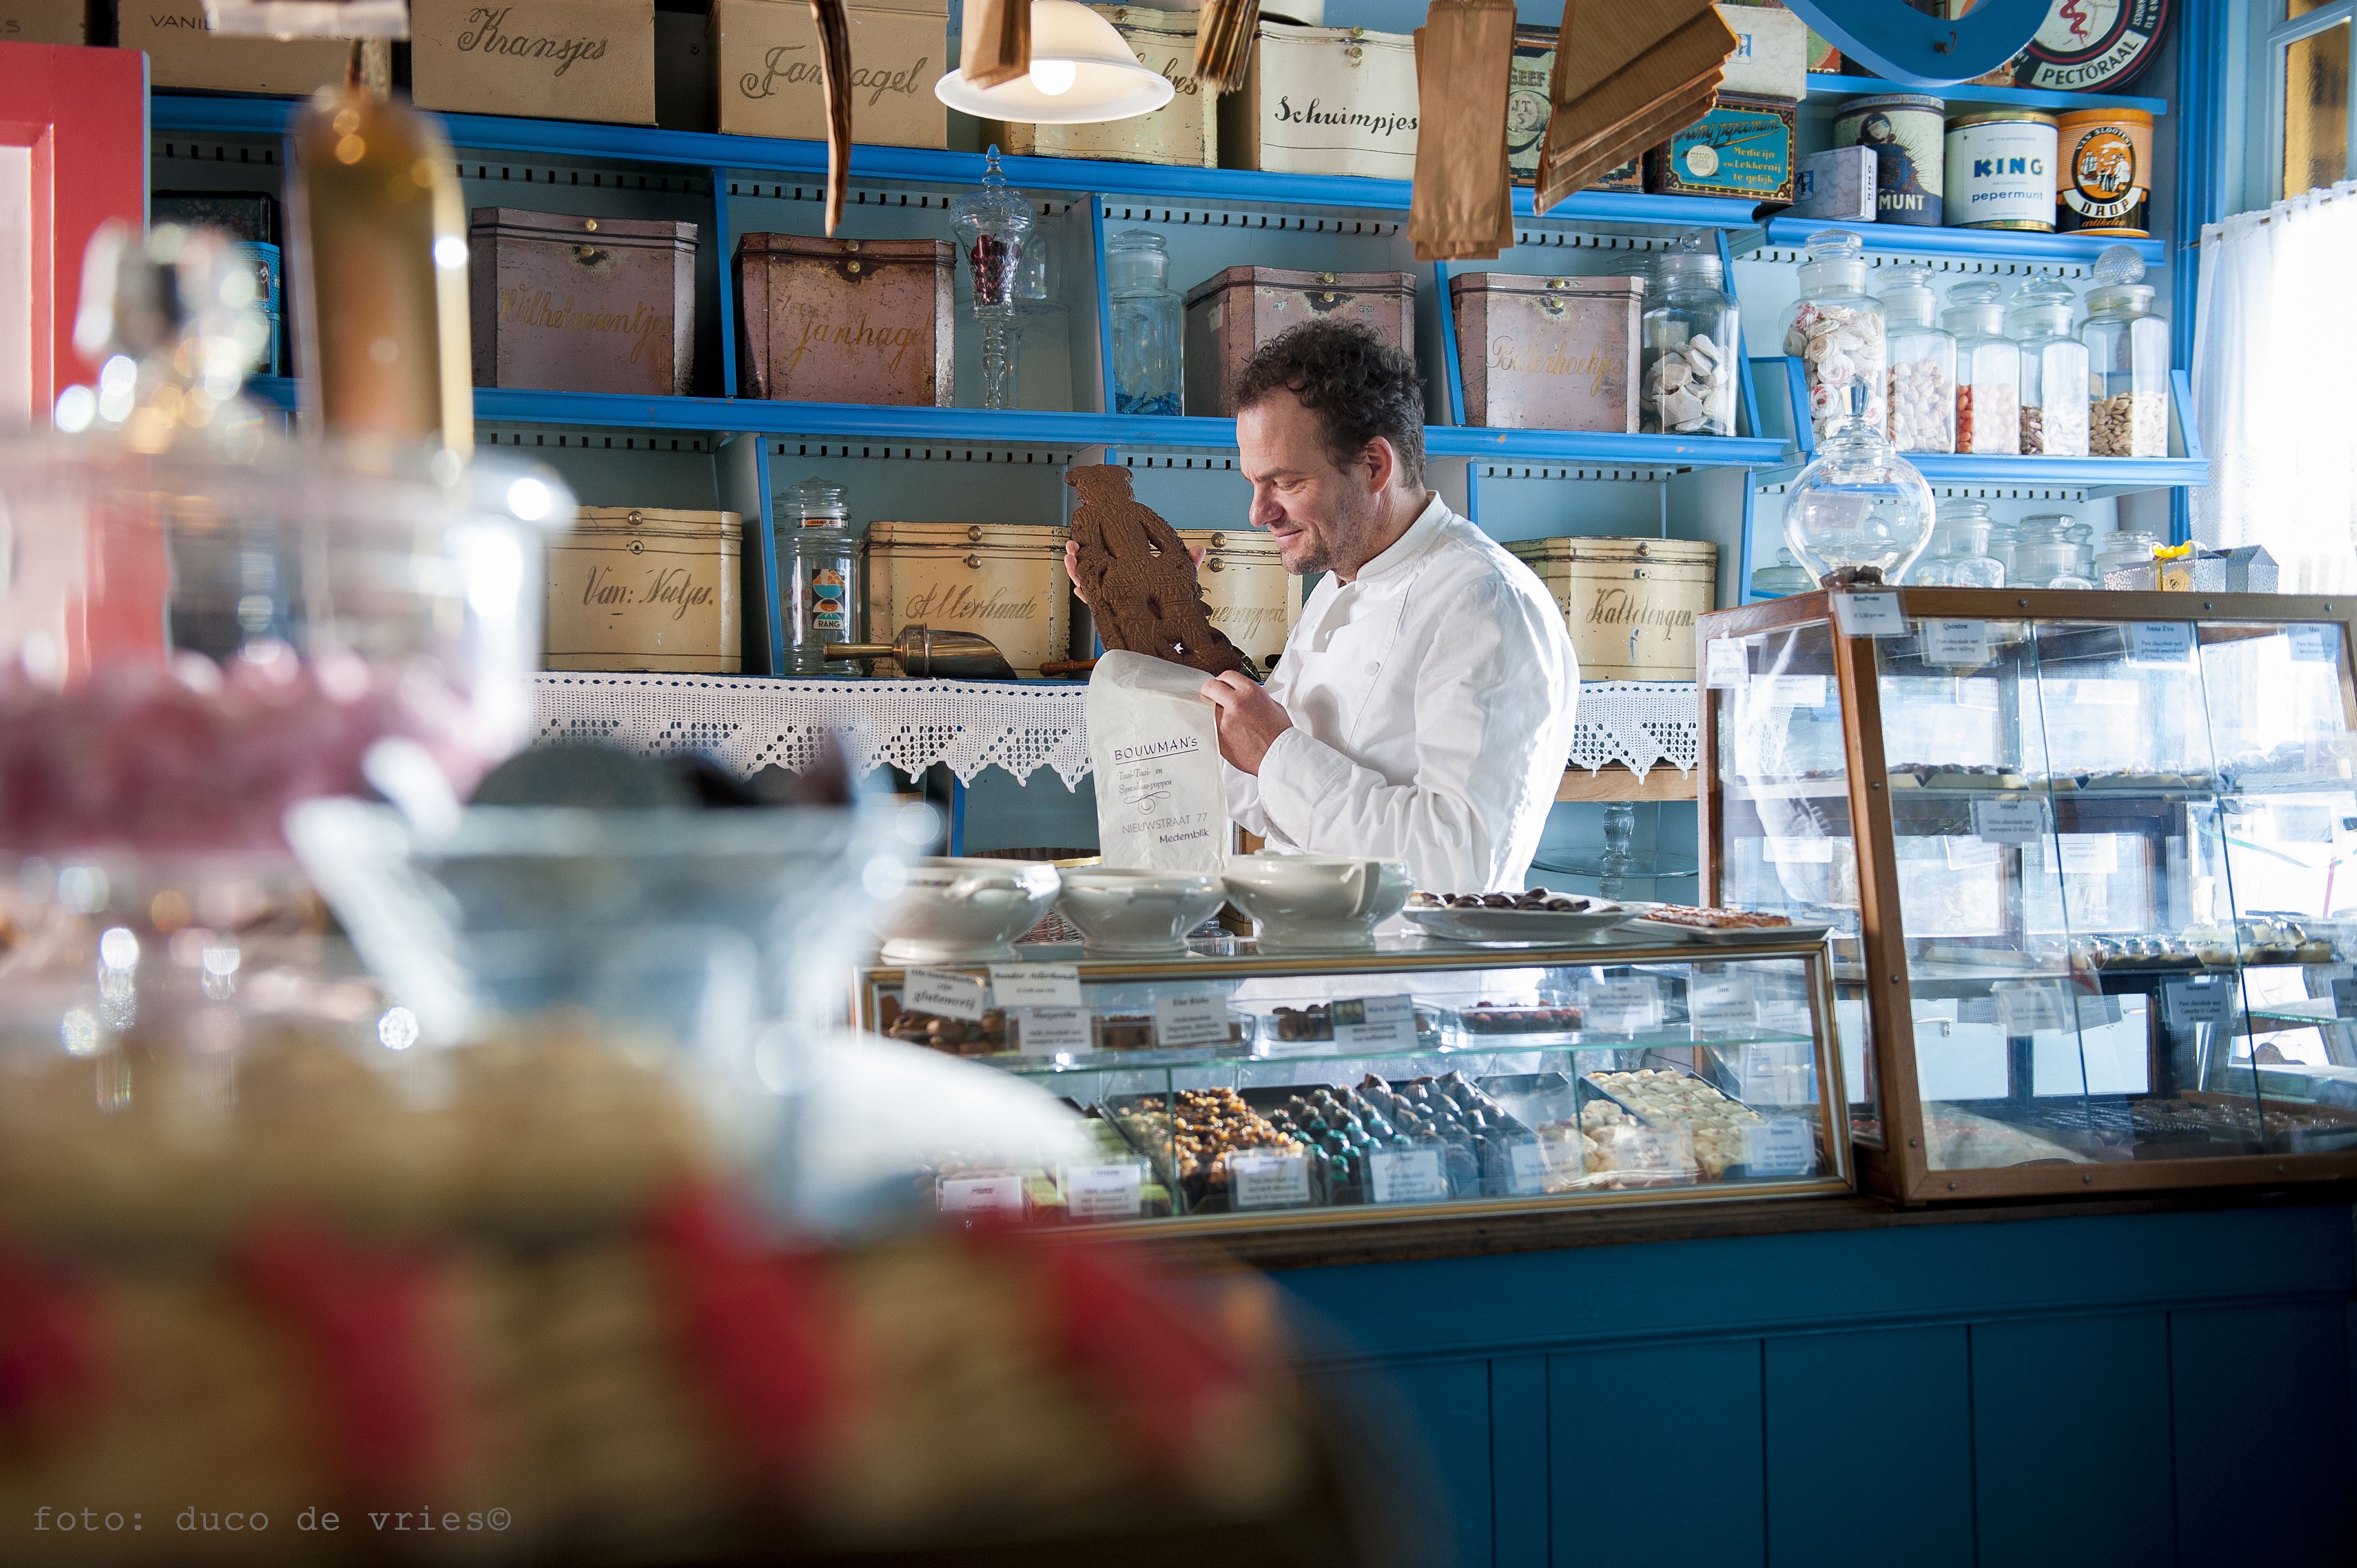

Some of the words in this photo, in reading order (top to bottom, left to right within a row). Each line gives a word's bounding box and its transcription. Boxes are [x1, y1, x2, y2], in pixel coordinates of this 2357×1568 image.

[150, 14, 213, 30] VANIL
[457, 6, 608, 77] Kransjes
[2041, 41, 2139, 84] PECTORAAL
[1274, 95, 1418, 136] Schuimpjes
[1733, 146, 1776, 160] Medicijn
[1735, 159, 1781, 174] Lekkernij
[1974, 157, 2043, 178] KING
[1972, 191, 2043, 203] pepermunt
[818, 620, 841, 628] RANG
[1114, 736, 1198, 761] BOUWMAN's
[1122, 814, 1191, 834] NIEUWSTRAAT
[1196, 812, 1207, 823] 77
[1159, 828, 1210, 844] Medemblik
